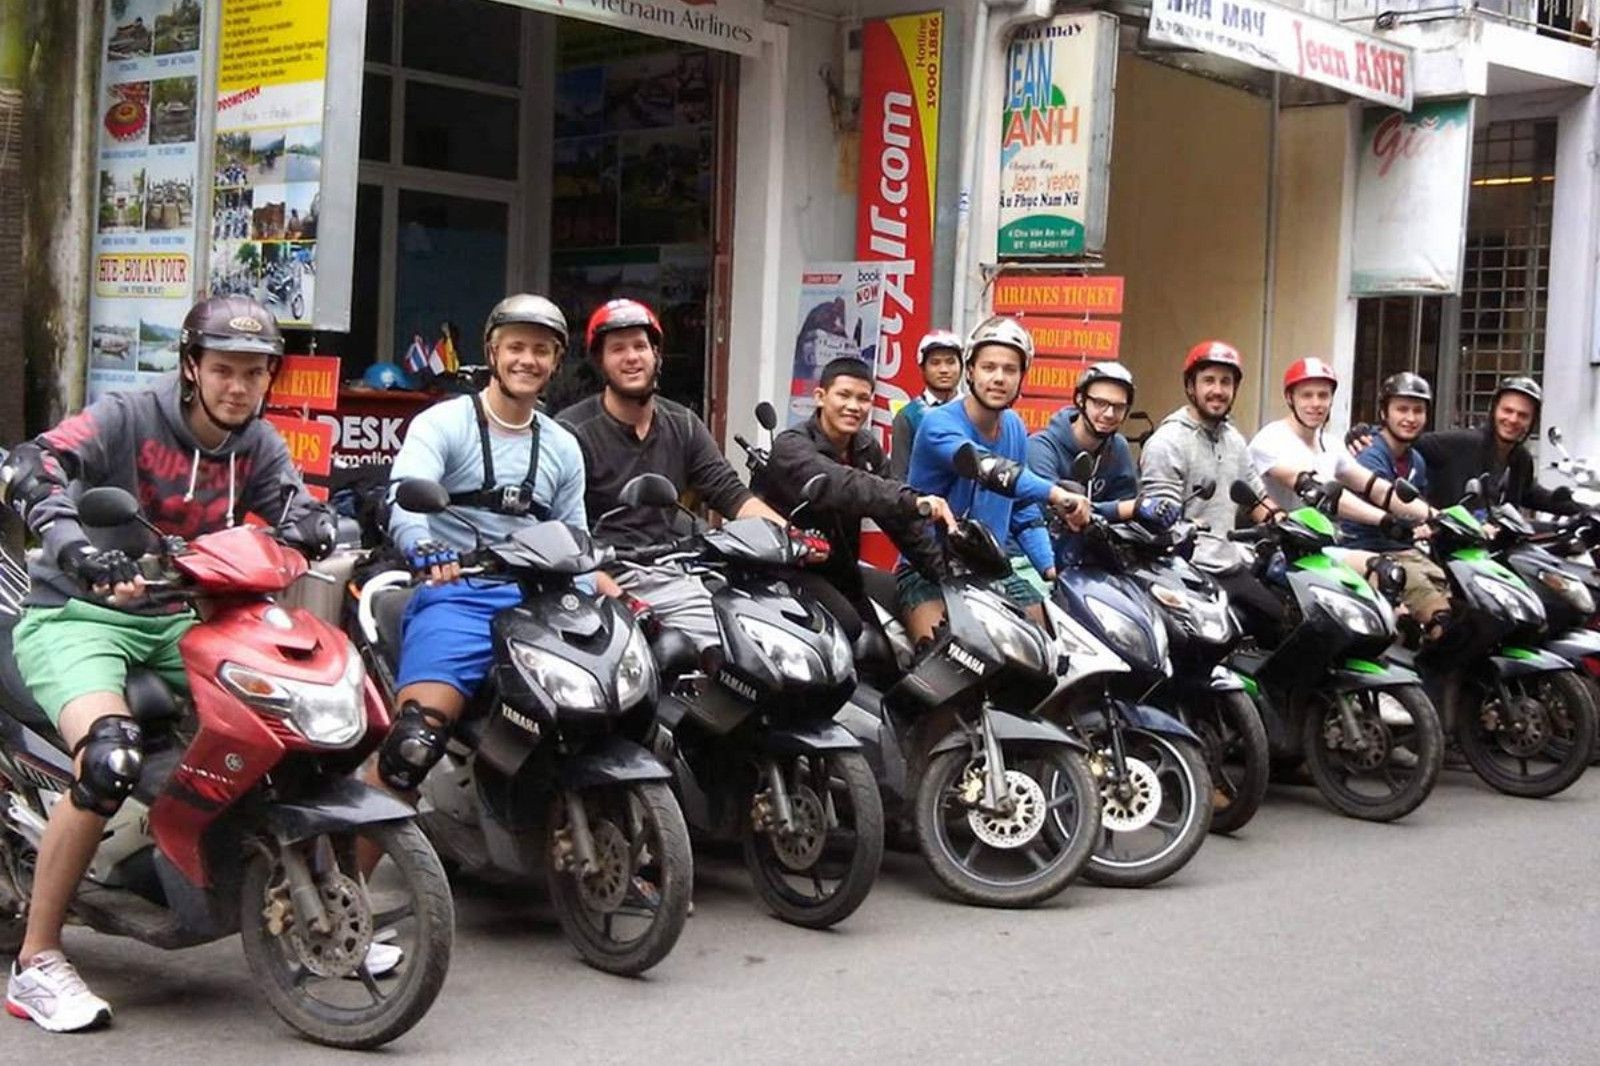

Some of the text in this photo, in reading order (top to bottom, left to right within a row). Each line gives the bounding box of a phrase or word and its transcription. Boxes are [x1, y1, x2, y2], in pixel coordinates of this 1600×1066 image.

[682, 8, 754, 43] Airlines
[1222, 2, 1265, 37] MAY
[926, 17, 940, 110] 1900 1886
[1292, 19, 1350, 78] Jean
[1354, 39, 1406, 99] ANH
[1002, 105, 1080, 150] ANH
[160, 259, 186, 282] TOUR
[858, 268, 879, 283] book
[855, 284, 879, 304] NOW
[996, 285, 1117, 308] AIRLINES TICKET
[1031, 326, 1112, 352] GROUP TOURS
[291, 369, 333, 398] RENTAL
[1027, 366, 1067, 389] RIDER
[947, 641, 986, 677] YAMAHA
[718, 669, 759, 702] YAMAHA
[501, 702, 541, 737] YAMAHA
